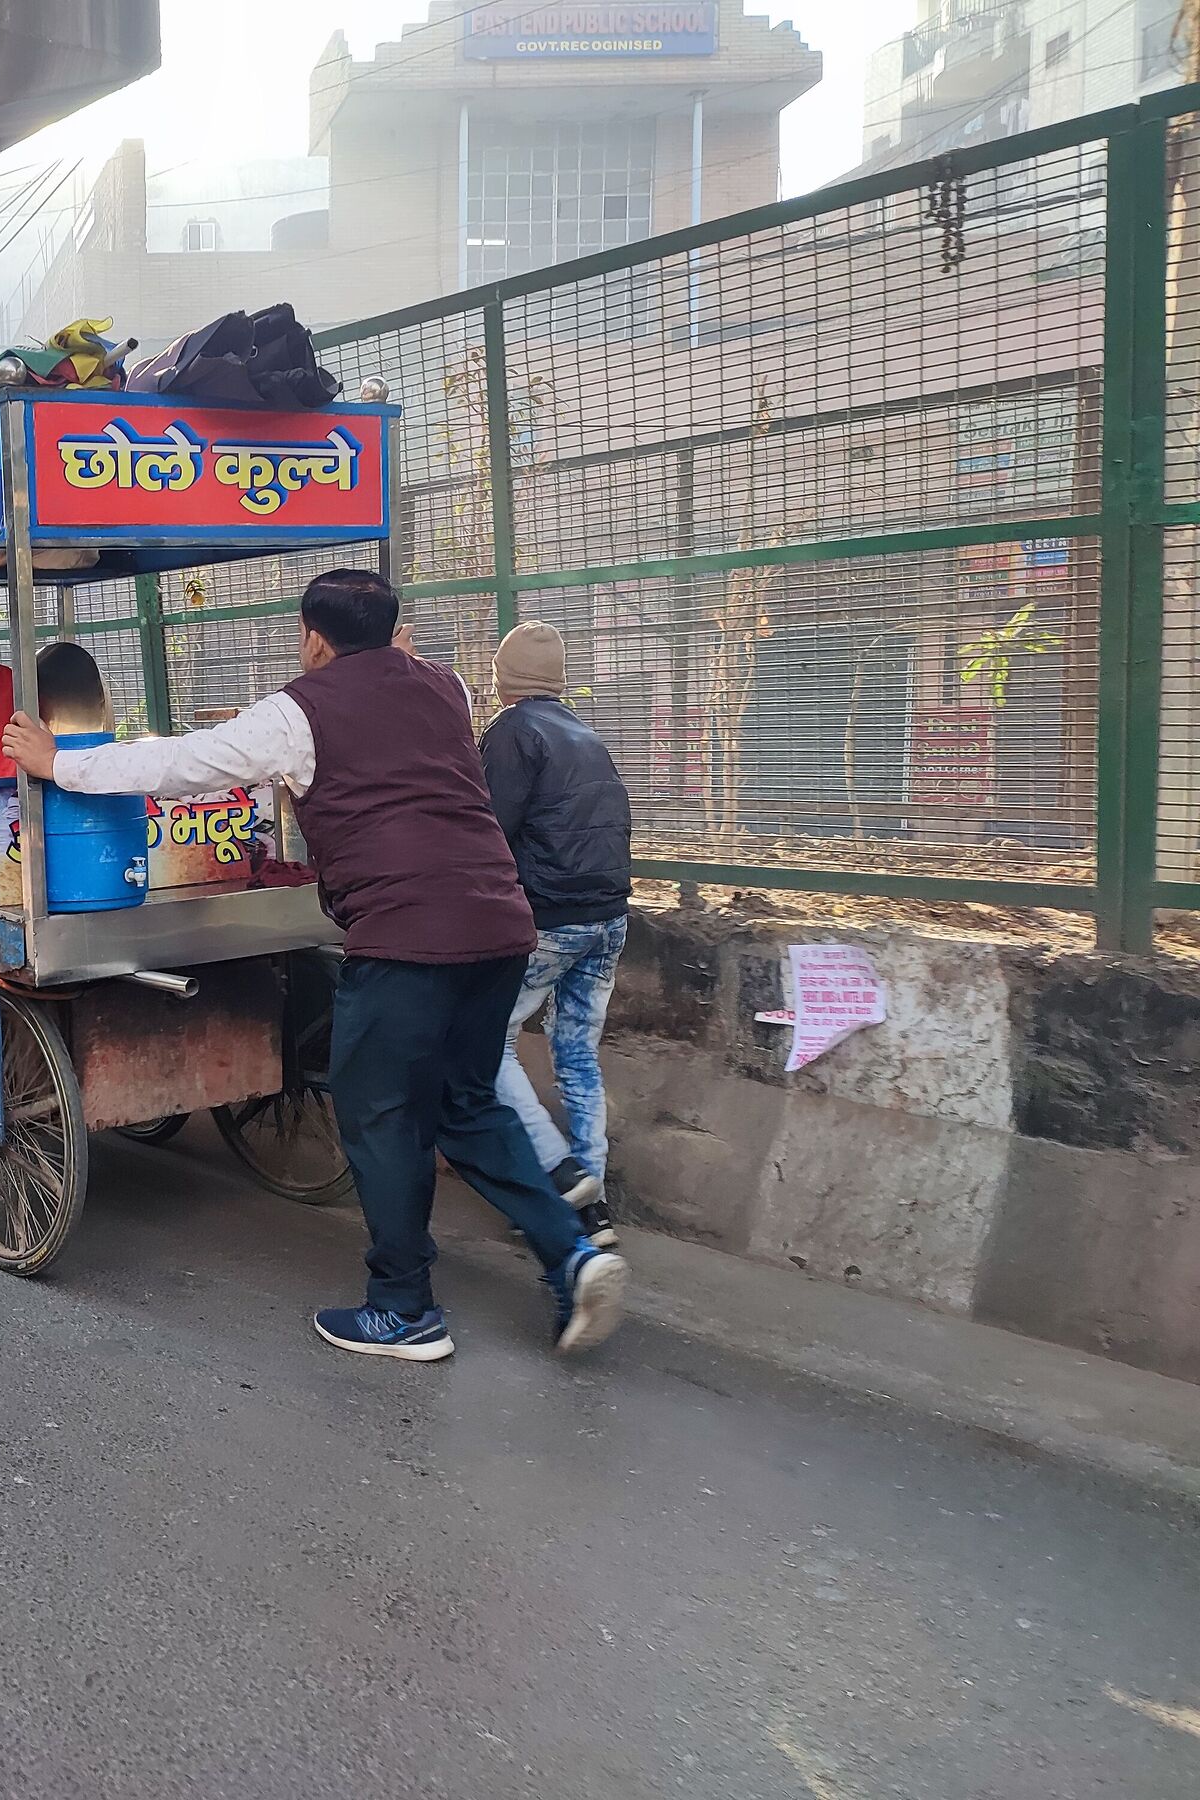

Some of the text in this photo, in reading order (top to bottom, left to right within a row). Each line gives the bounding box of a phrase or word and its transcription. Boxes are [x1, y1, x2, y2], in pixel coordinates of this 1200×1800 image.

[520, 7, 560, 34] END
[560, 6, 628, 34] PUBLIC
[632, 5, 707, 33] SCHOOL
[56, 416, 363, 516] छोले कुल्चे
[170, 786, 258, 863] भटूरे
